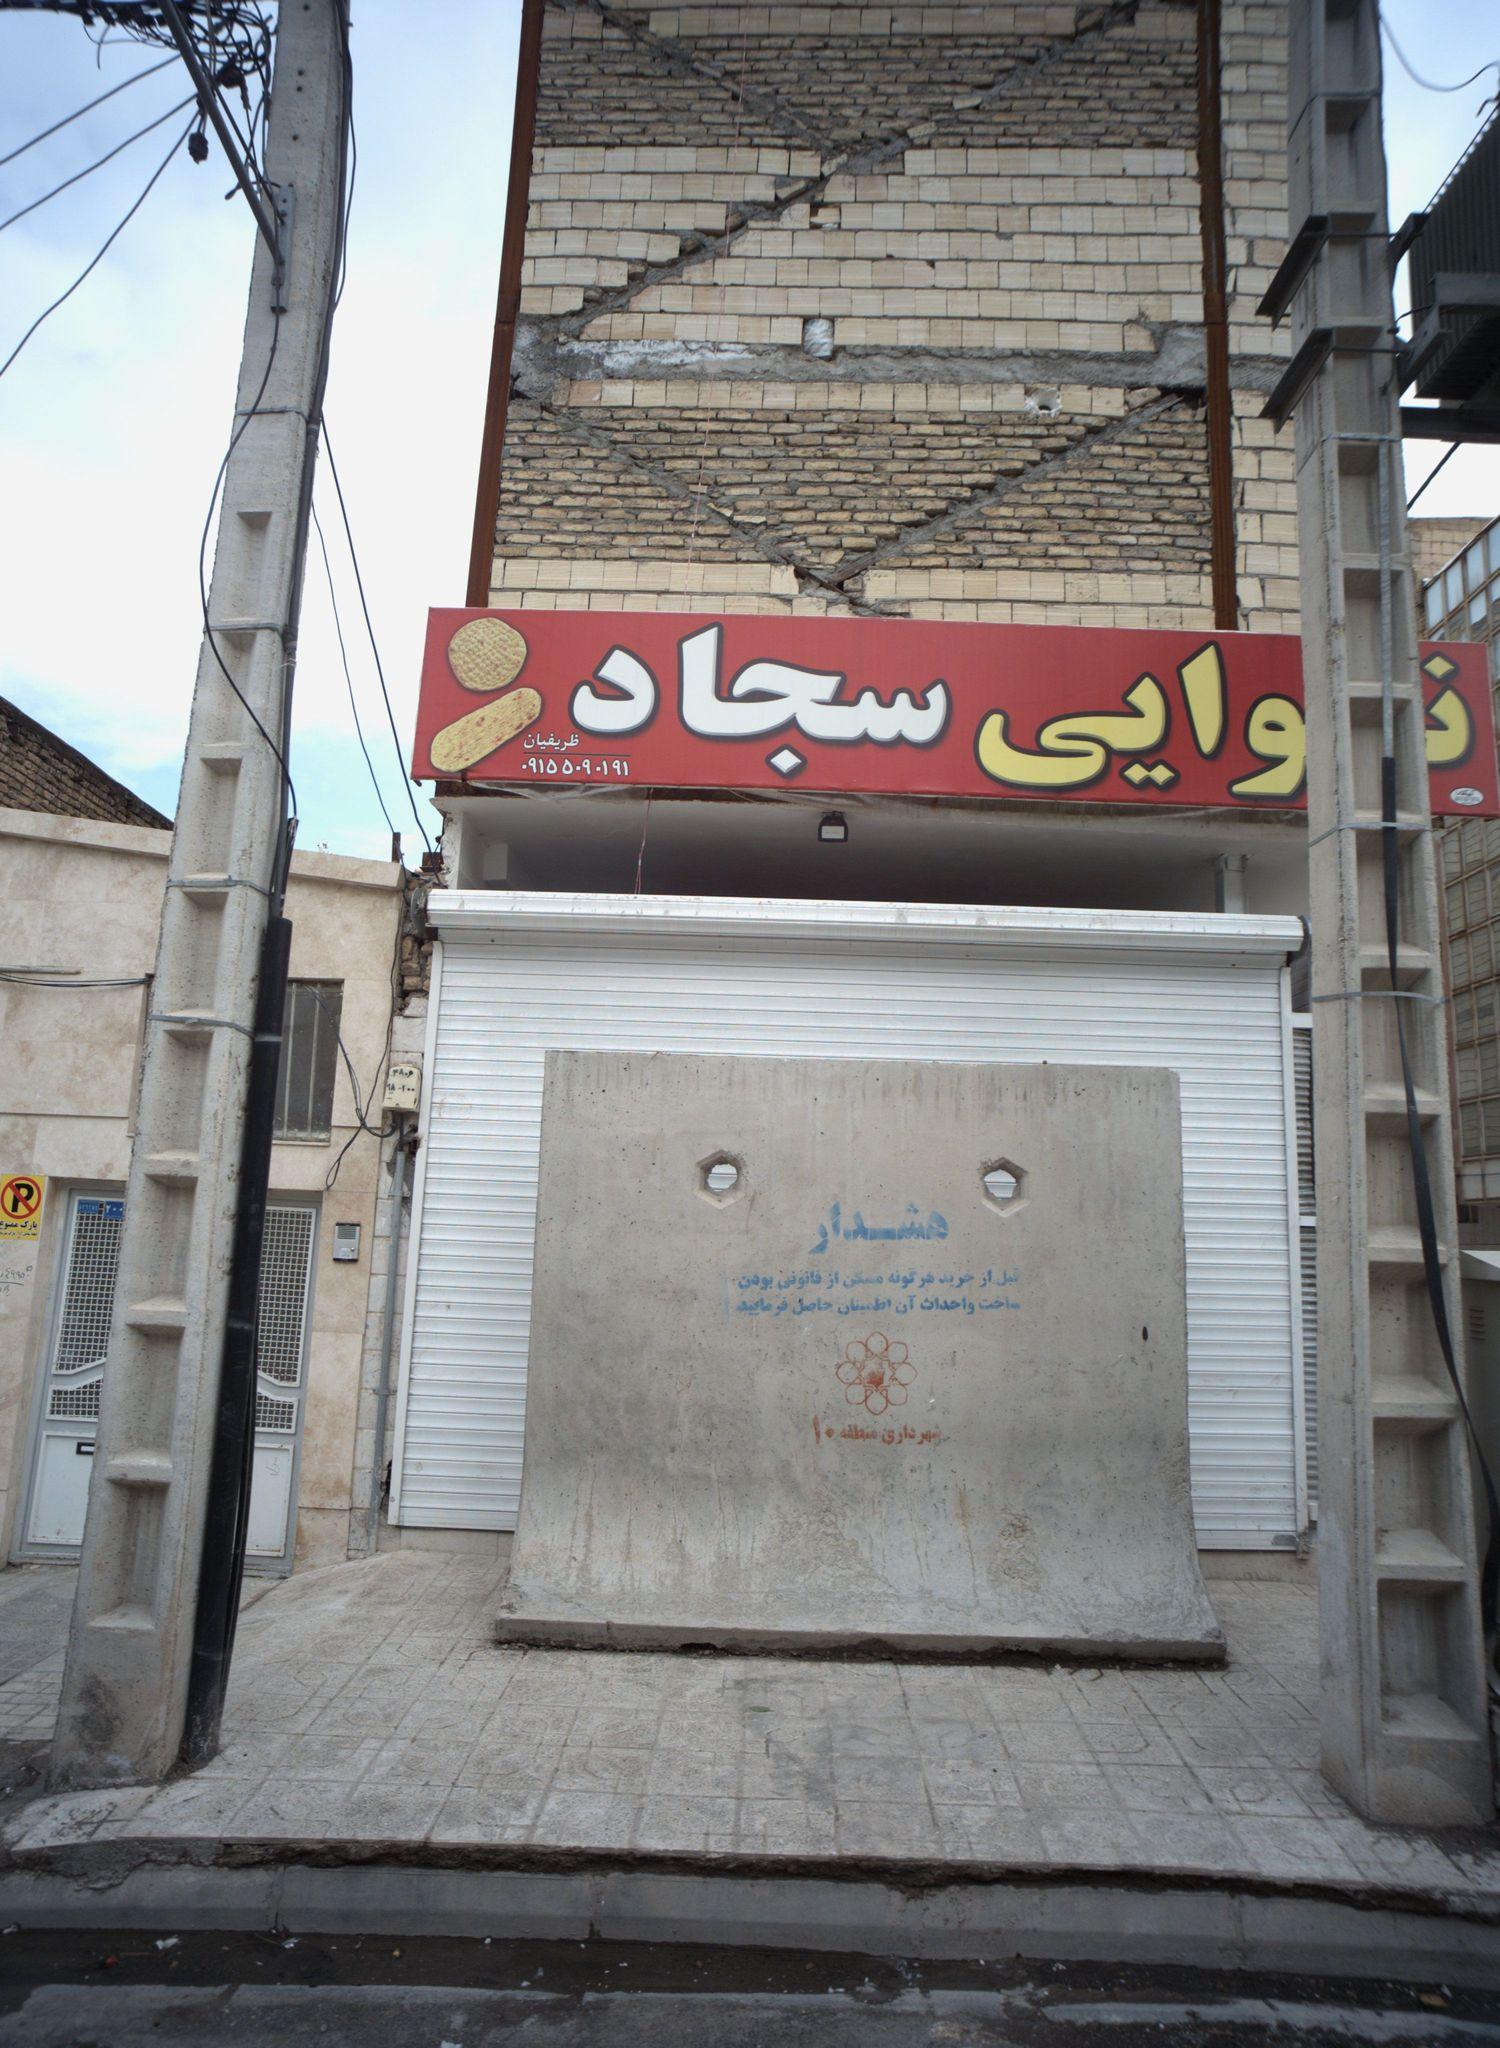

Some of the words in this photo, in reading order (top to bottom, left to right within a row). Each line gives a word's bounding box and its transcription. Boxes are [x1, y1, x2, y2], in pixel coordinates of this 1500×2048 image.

[570, 624, 950, 777] سجاد
[523, 733, 579, 750] ظریفیان
[808, 1201, 948, 1254] هشدار
[778, 1270, 822, 1291] قانونی
[826, 1269, 839, 1290] از
[979, 1268, 992, 1288] از
[792, 1296, 833, 1316] حاصل
[895, 1294, 916, 1314] آن
[840, 1423, 880, 1441] منطقه
